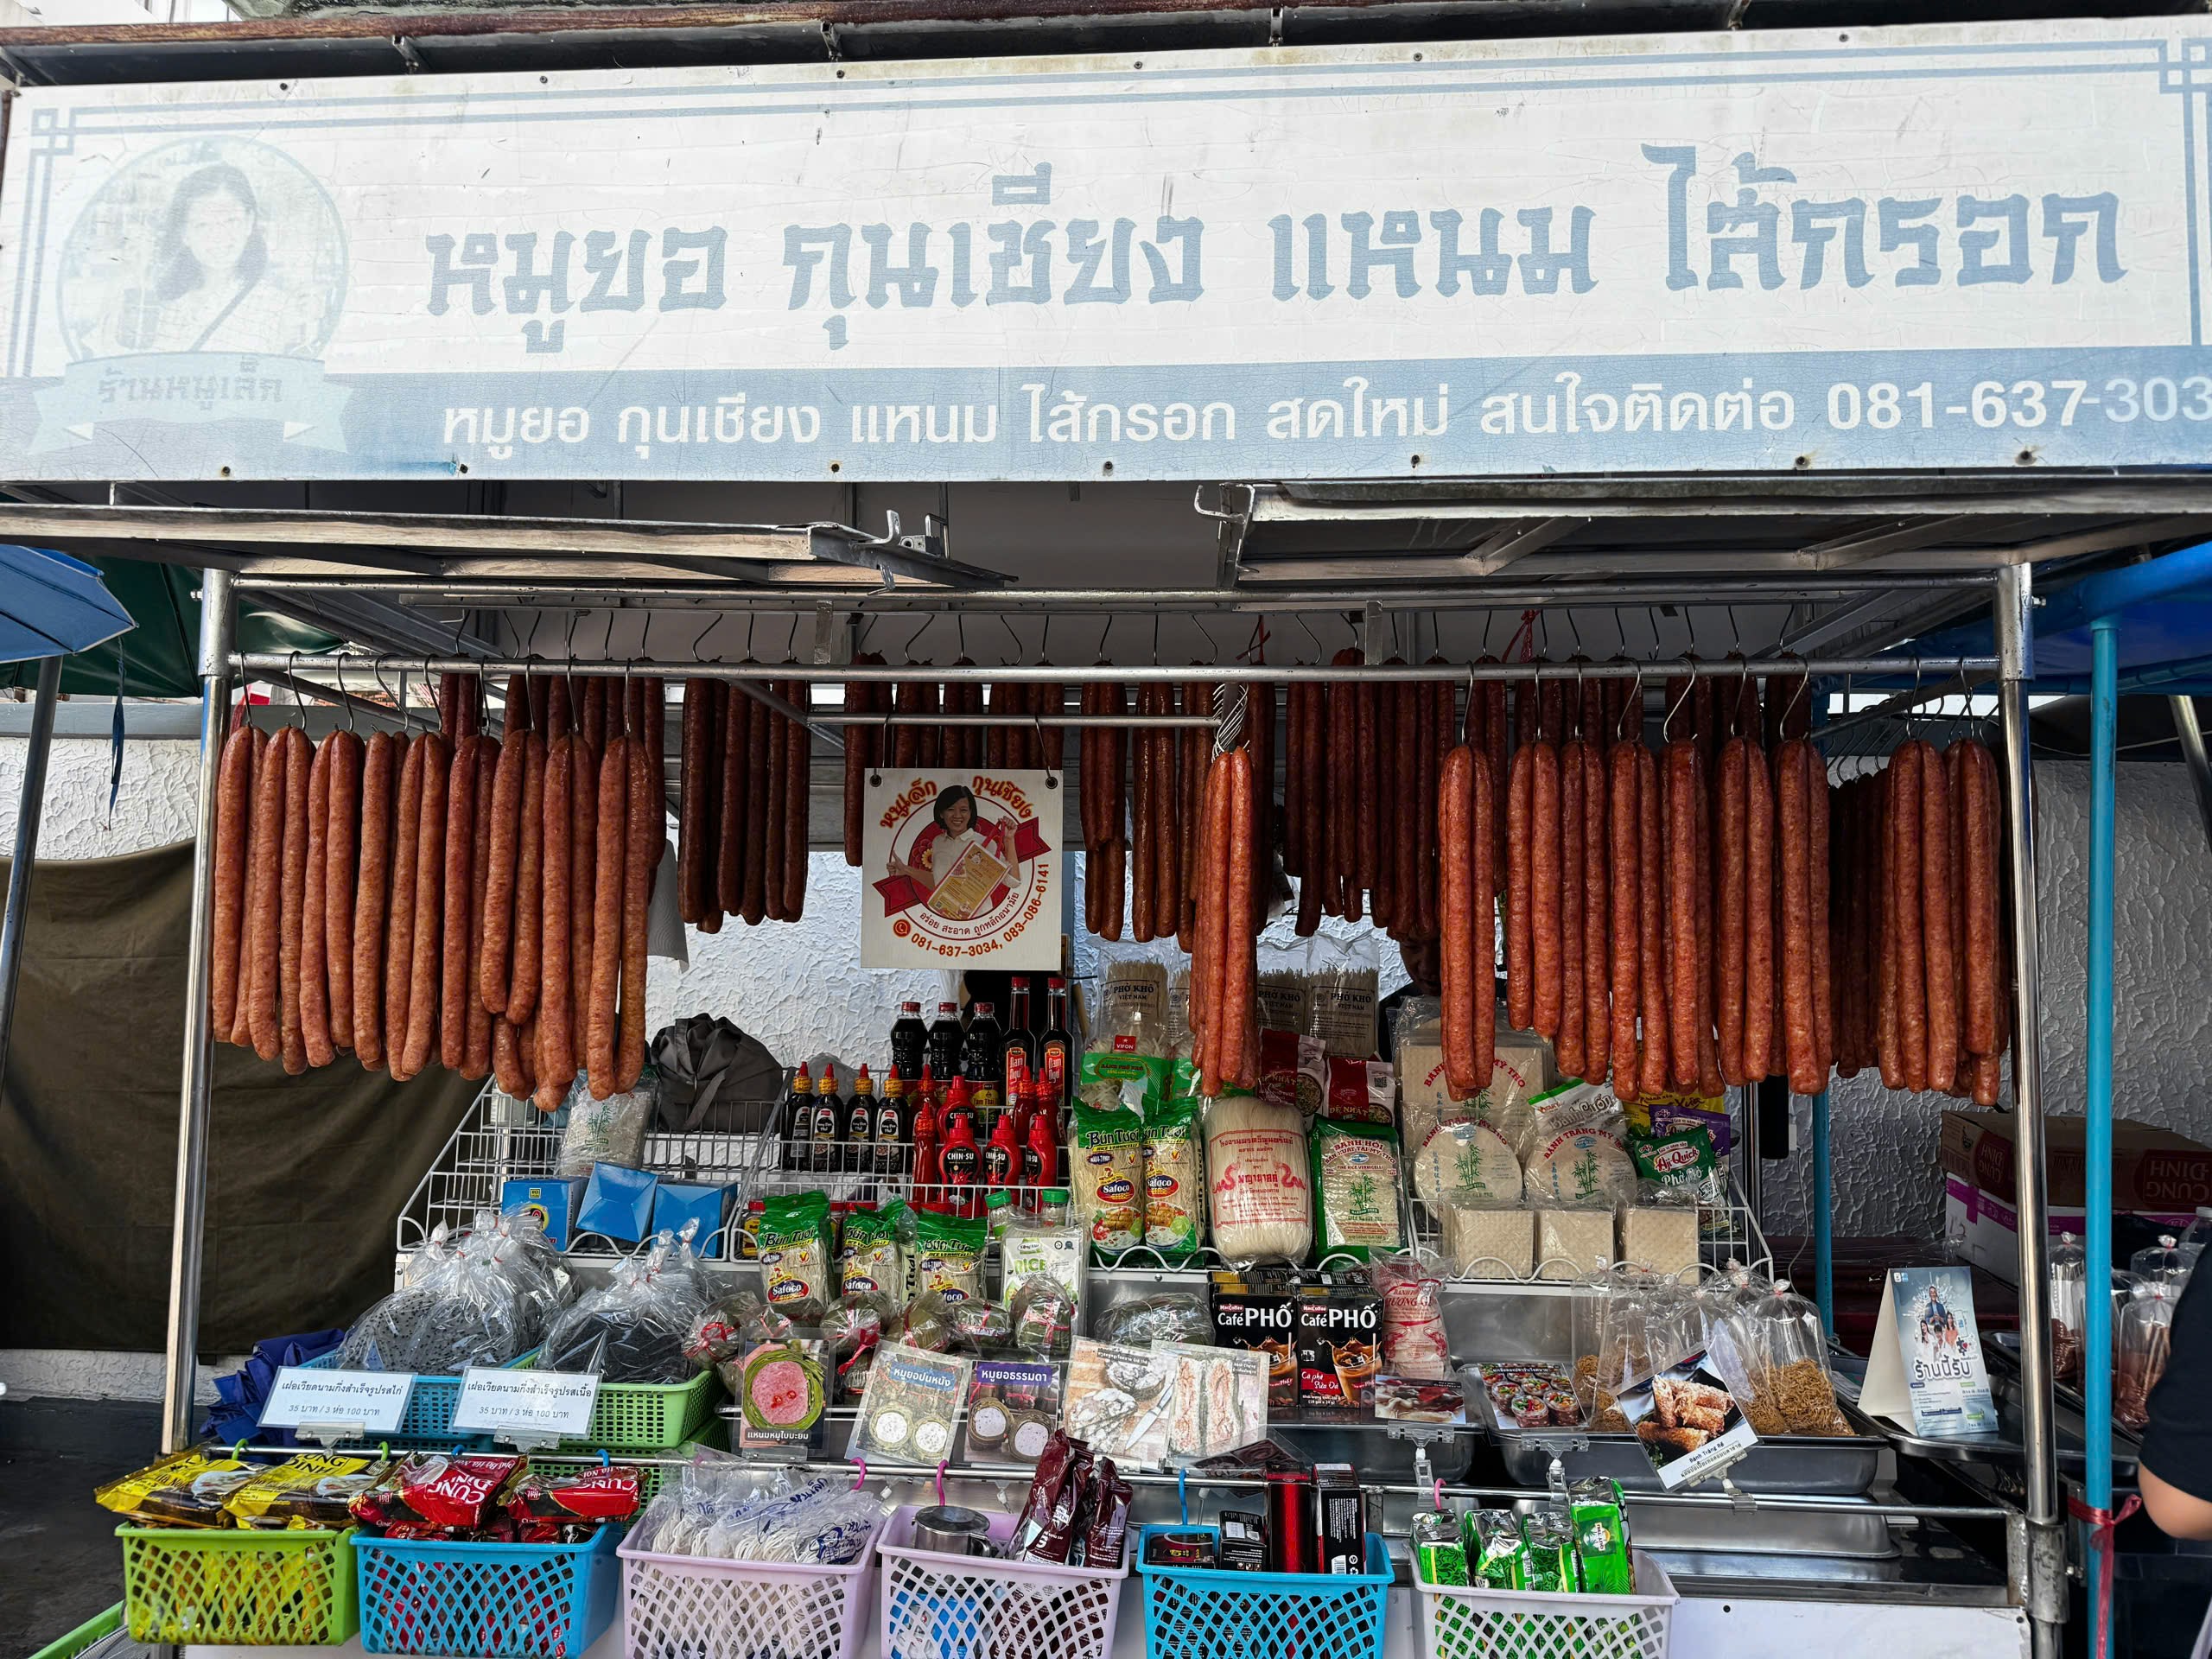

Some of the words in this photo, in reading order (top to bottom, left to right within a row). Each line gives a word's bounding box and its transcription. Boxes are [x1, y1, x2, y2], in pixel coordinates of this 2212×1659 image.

[427, 226, 728, 353] หมูยอ
[783, 162, 1205, 350] กุนเชียง
[1268, 206, 1599, 302] แหนม
[1641, 143, 2128, 291] ไส้กรอก
[444, 405, 589, 460] หมูยอ
[618, 392, 819, 460] กุนเชียง
[851, 403, 997, 443] แหนม
[1022, 383, 1236, 443] ไส้กรอก
[1268, 376, 1448, 439] สดใหม่
[1480, 372, 1796, 435] สนใจติดต่อ
[880, 778, 938, 829] หนูเล็ก
[972, 776, 1033, 818] กุนเชียง
[919, 912, 939, 929] อร่อย
[942, 925, 970, 936] สะอาด
[1508, 1067, 1525, 1088] THO
[947, 1152, 975, 1160] CHIN-SU
[1655, 1147, 1699, 1173] Aji-Quick
[1103, 1184, 1130, 1193] Safoco
[1014, 1257, 1048, 1274] RICE
[772, 1283, 803, 1296] Safoco
[944, 1290, 963, 1303] foco
[1217, 1313, 1244, 1326] Café
[1245, 1302, 1293, 1328] PHỐ
[1300, 1313, 1328, 1327] Café
[1329, 1302, 1377, 1329] PHỐ
[982, 1369, 1047, 1383] หมูยอธรรมดา
[1915, 1354, 1971, 1379] ร้านนี้รับ
[893, 1368, 951, 1388] หมูยอปนหนัง
[282, 1380, 404, 1397] เฝอเวียดนามกึ่งสำเร็จรูปรสไก่
[467, 1380, 592, 1399] เฝอเวียดนามกึ่งสำเร็จรูปรสเนื้อ
[302, 1404, 318, 1413] บาท
[333, 1404, 344, 1415] ห่อ
[491, 1407, 507, 1415] บาท
[522, 1406, 533, 1417] ห่อ
[553, 1410, 569, 1419] บาท
